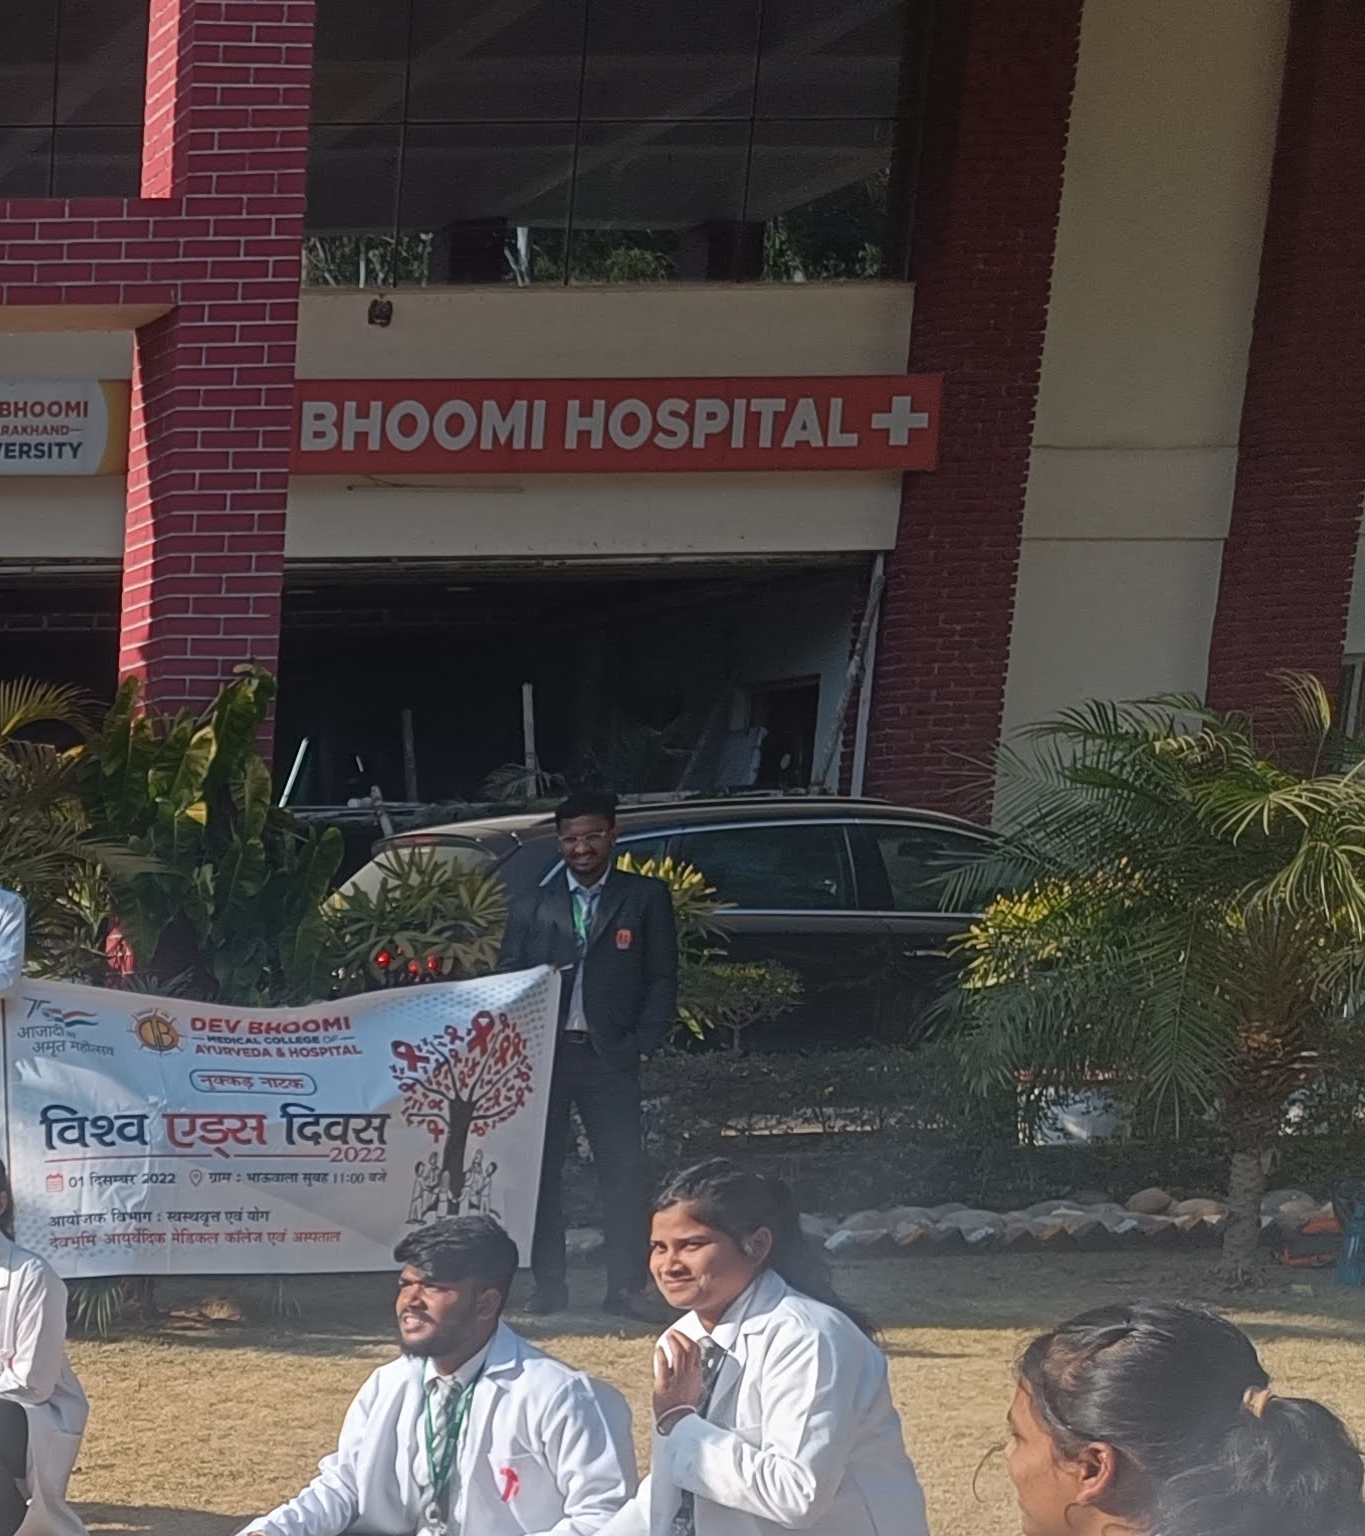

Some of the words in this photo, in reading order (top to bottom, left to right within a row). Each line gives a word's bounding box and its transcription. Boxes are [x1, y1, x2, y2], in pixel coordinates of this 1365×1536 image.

[300, 399, 546, 451] BHOOMI
[564, 398, 859, 450] HOSPITAL
[190, 1017, 242, 1034] DEV
[248, 1016, 352, 1035] BHOOMI
[206, 1036, 261, 1045] MEDICAL
[264, 1036, 320, 1045] COLLEGE
[195, 1044, 273, 1058] AYURVEDA
[289, 1045, 363, 1058] HOSPITAL
[39, 1104, 150, 1150] विश्व
[161, 1113, 268, 1159] एड्स
[279, 1102, 392, 1146] दिवस
[329, 1146, 387, 1163] 2022
[68, 1175, 85, 1188] 01
[141, 1173, 176, 1185] 2022
